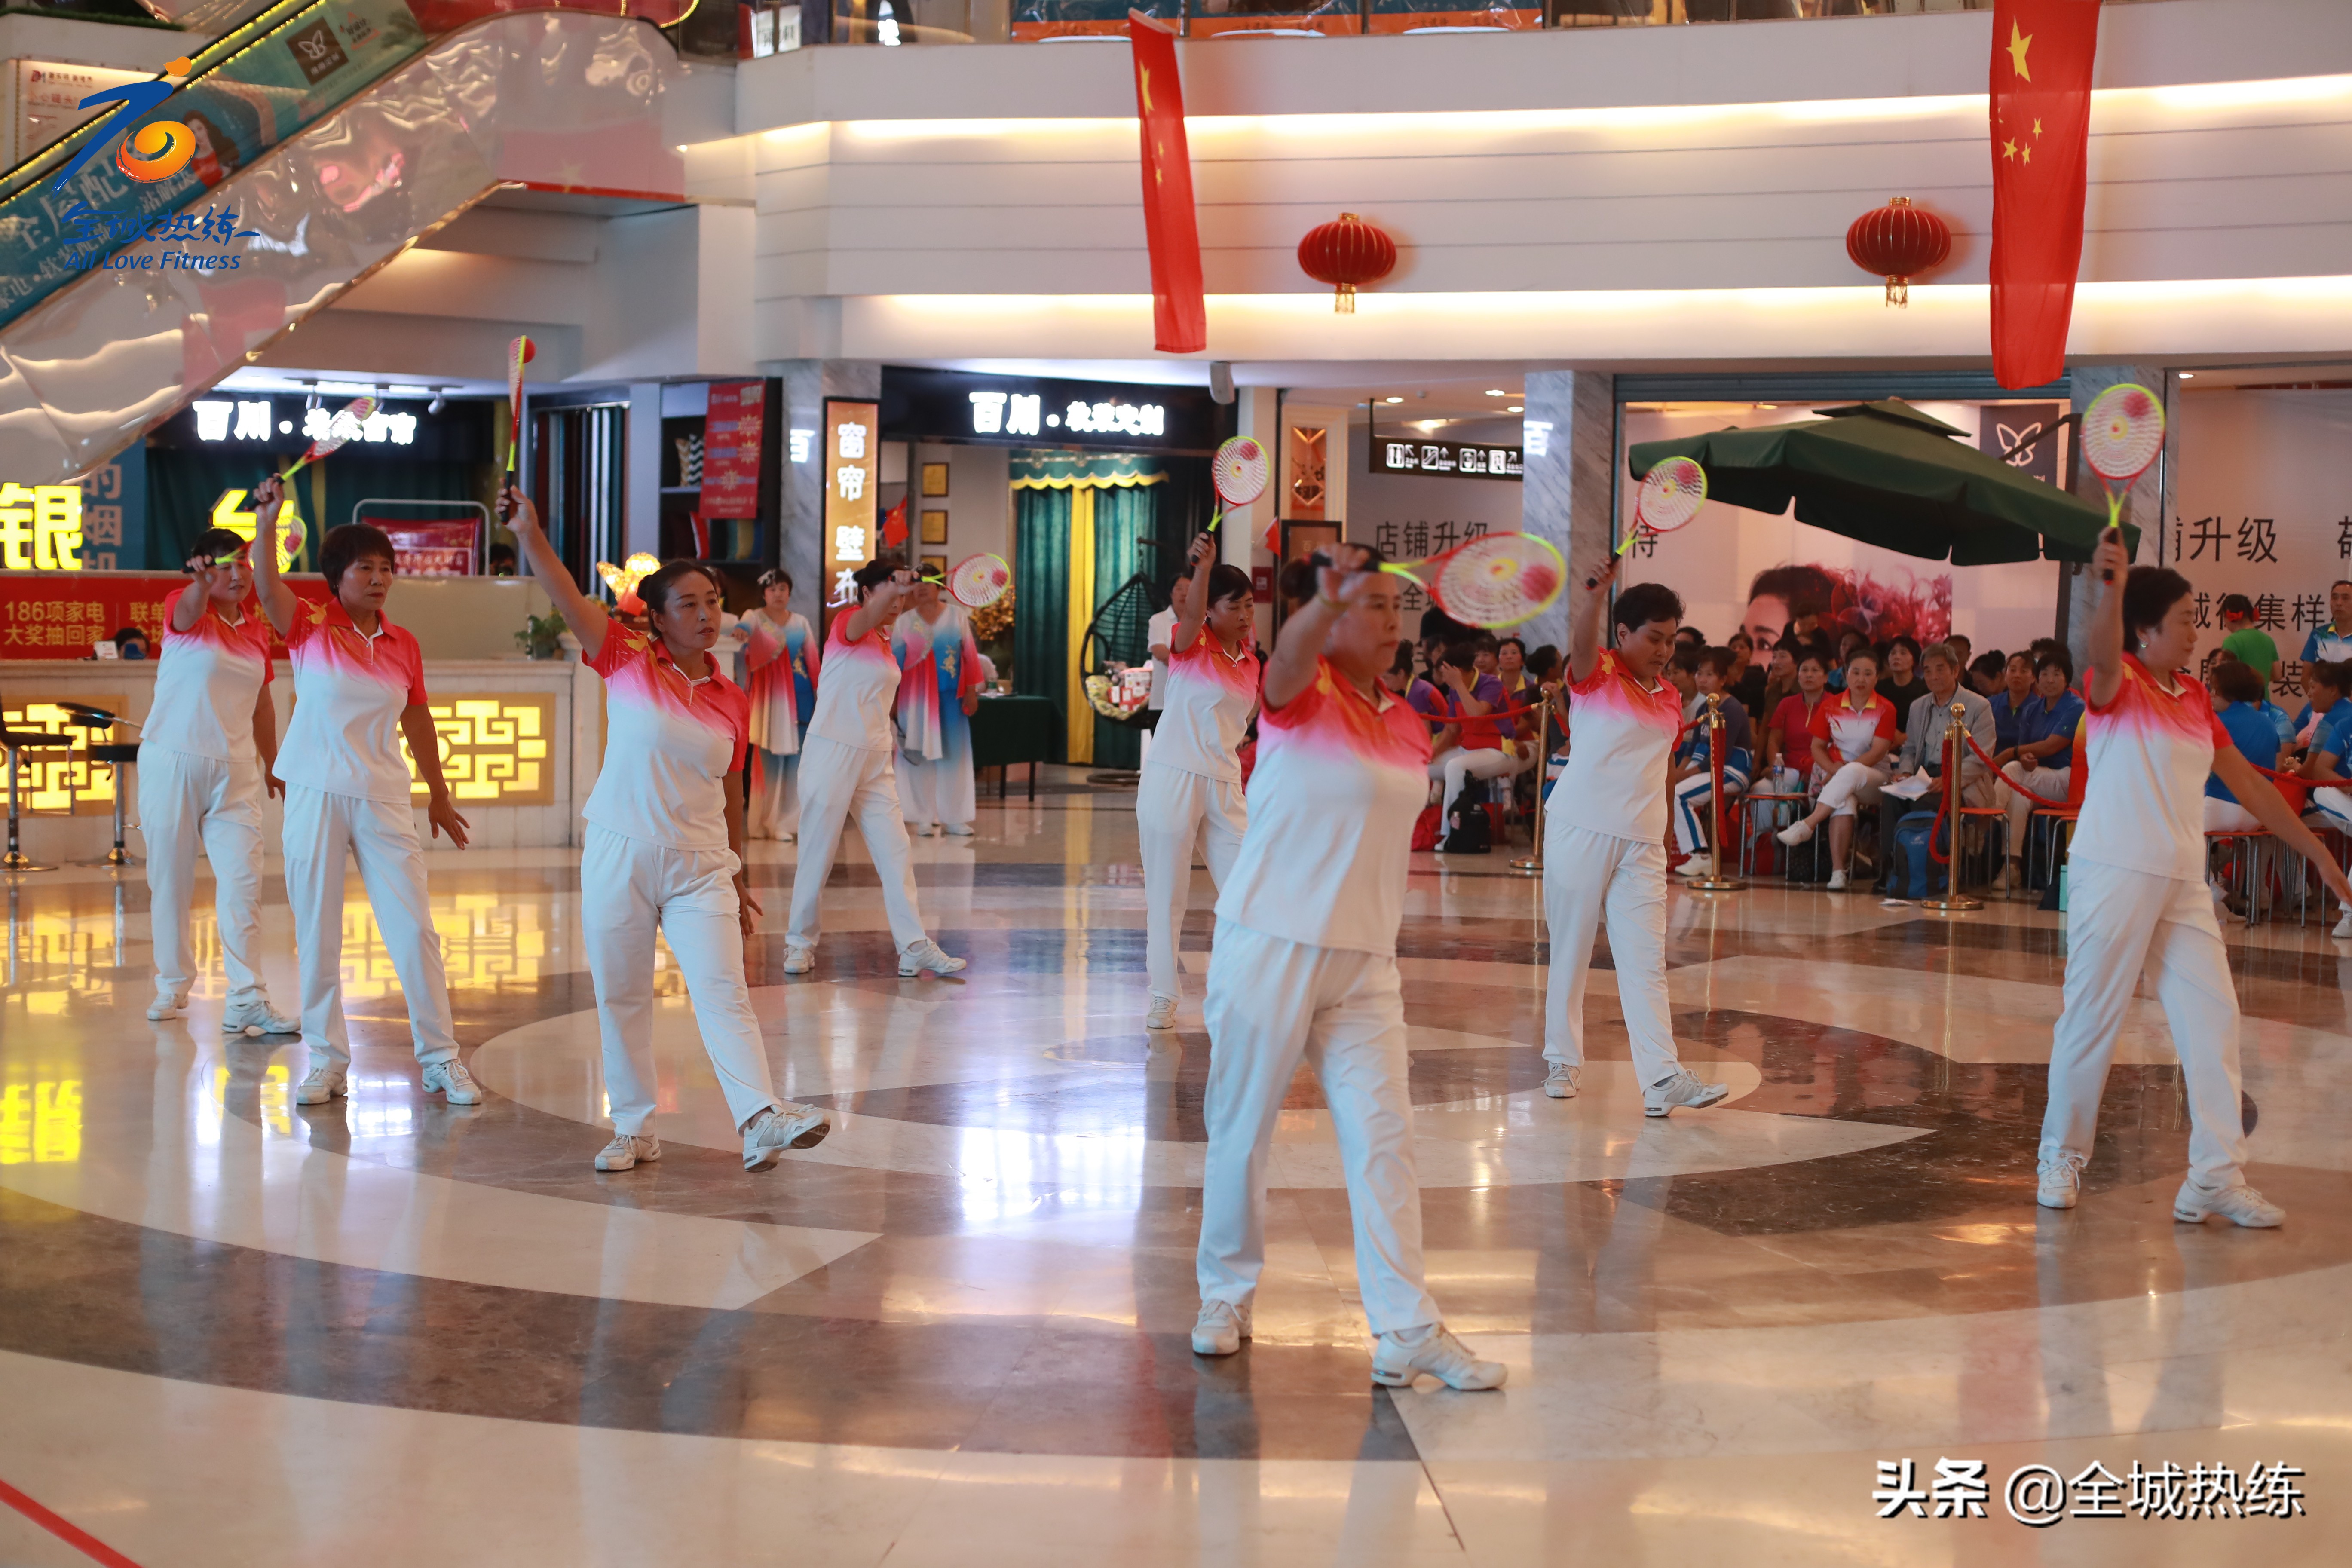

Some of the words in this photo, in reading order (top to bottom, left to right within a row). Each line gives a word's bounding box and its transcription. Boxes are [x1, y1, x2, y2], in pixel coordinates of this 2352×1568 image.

[4, 601, 105, 622] 186项家电
[3, 624, 105, 646] 大奖抽回家
